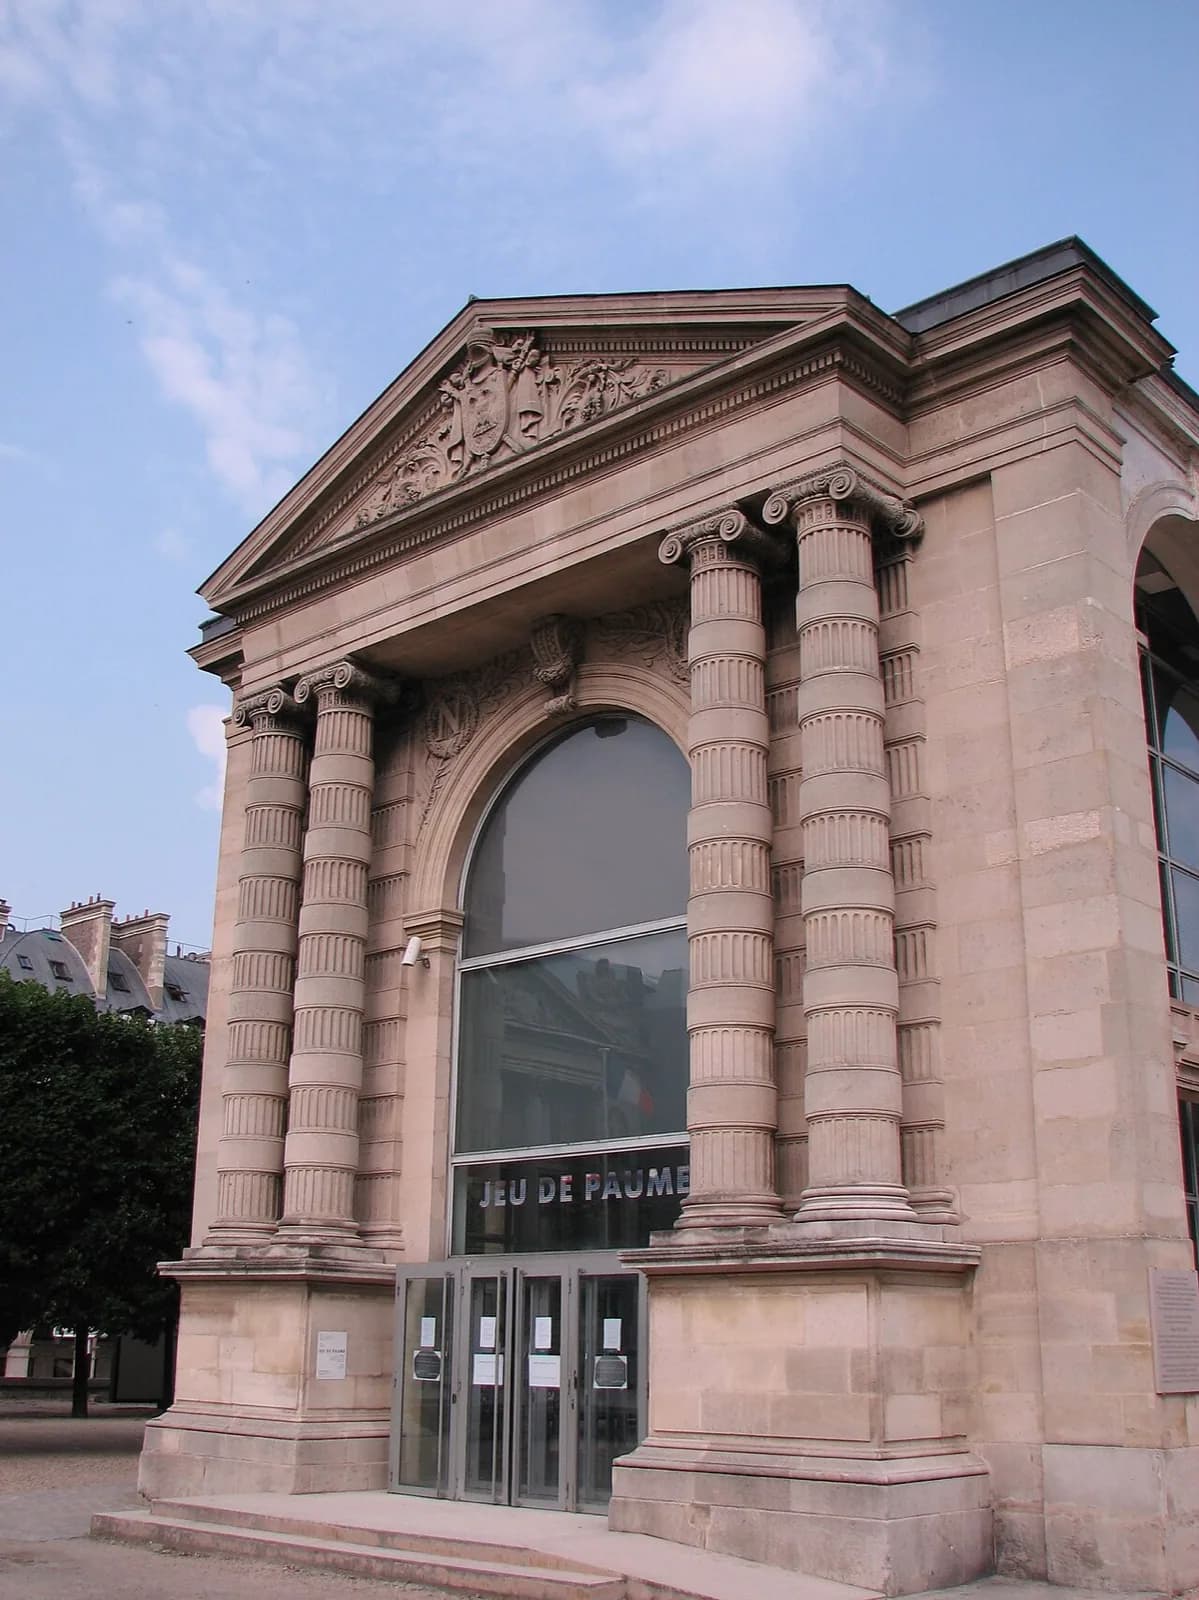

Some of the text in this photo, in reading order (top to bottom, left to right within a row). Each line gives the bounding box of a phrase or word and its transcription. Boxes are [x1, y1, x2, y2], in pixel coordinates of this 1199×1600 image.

[479, 1165, 690, 1208] JEU DE PAUME
